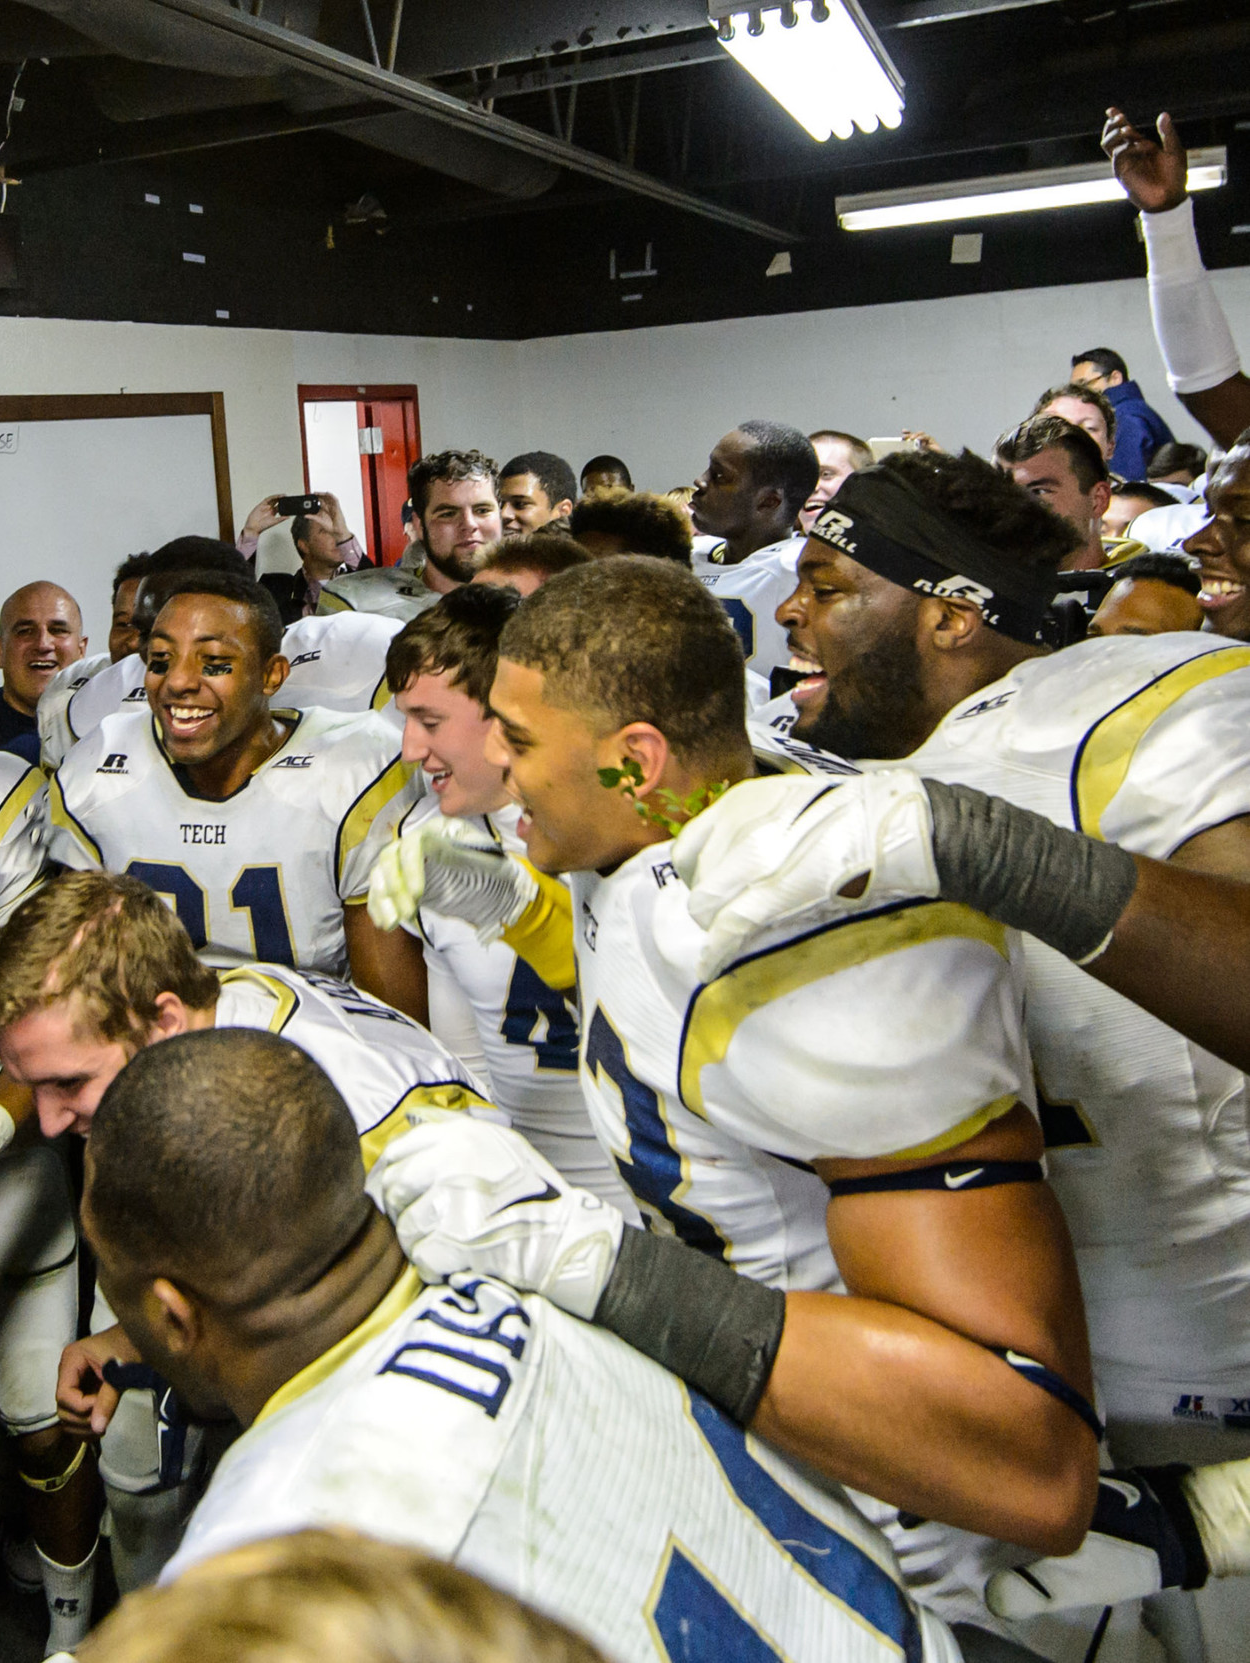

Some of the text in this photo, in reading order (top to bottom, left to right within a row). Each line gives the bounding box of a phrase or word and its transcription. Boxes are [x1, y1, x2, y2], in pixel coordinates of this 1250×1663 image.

[290, 650, 322, 668] ACC
[271, 754, 316, 769] ACC
[180, 823, 227, 845] TECH
